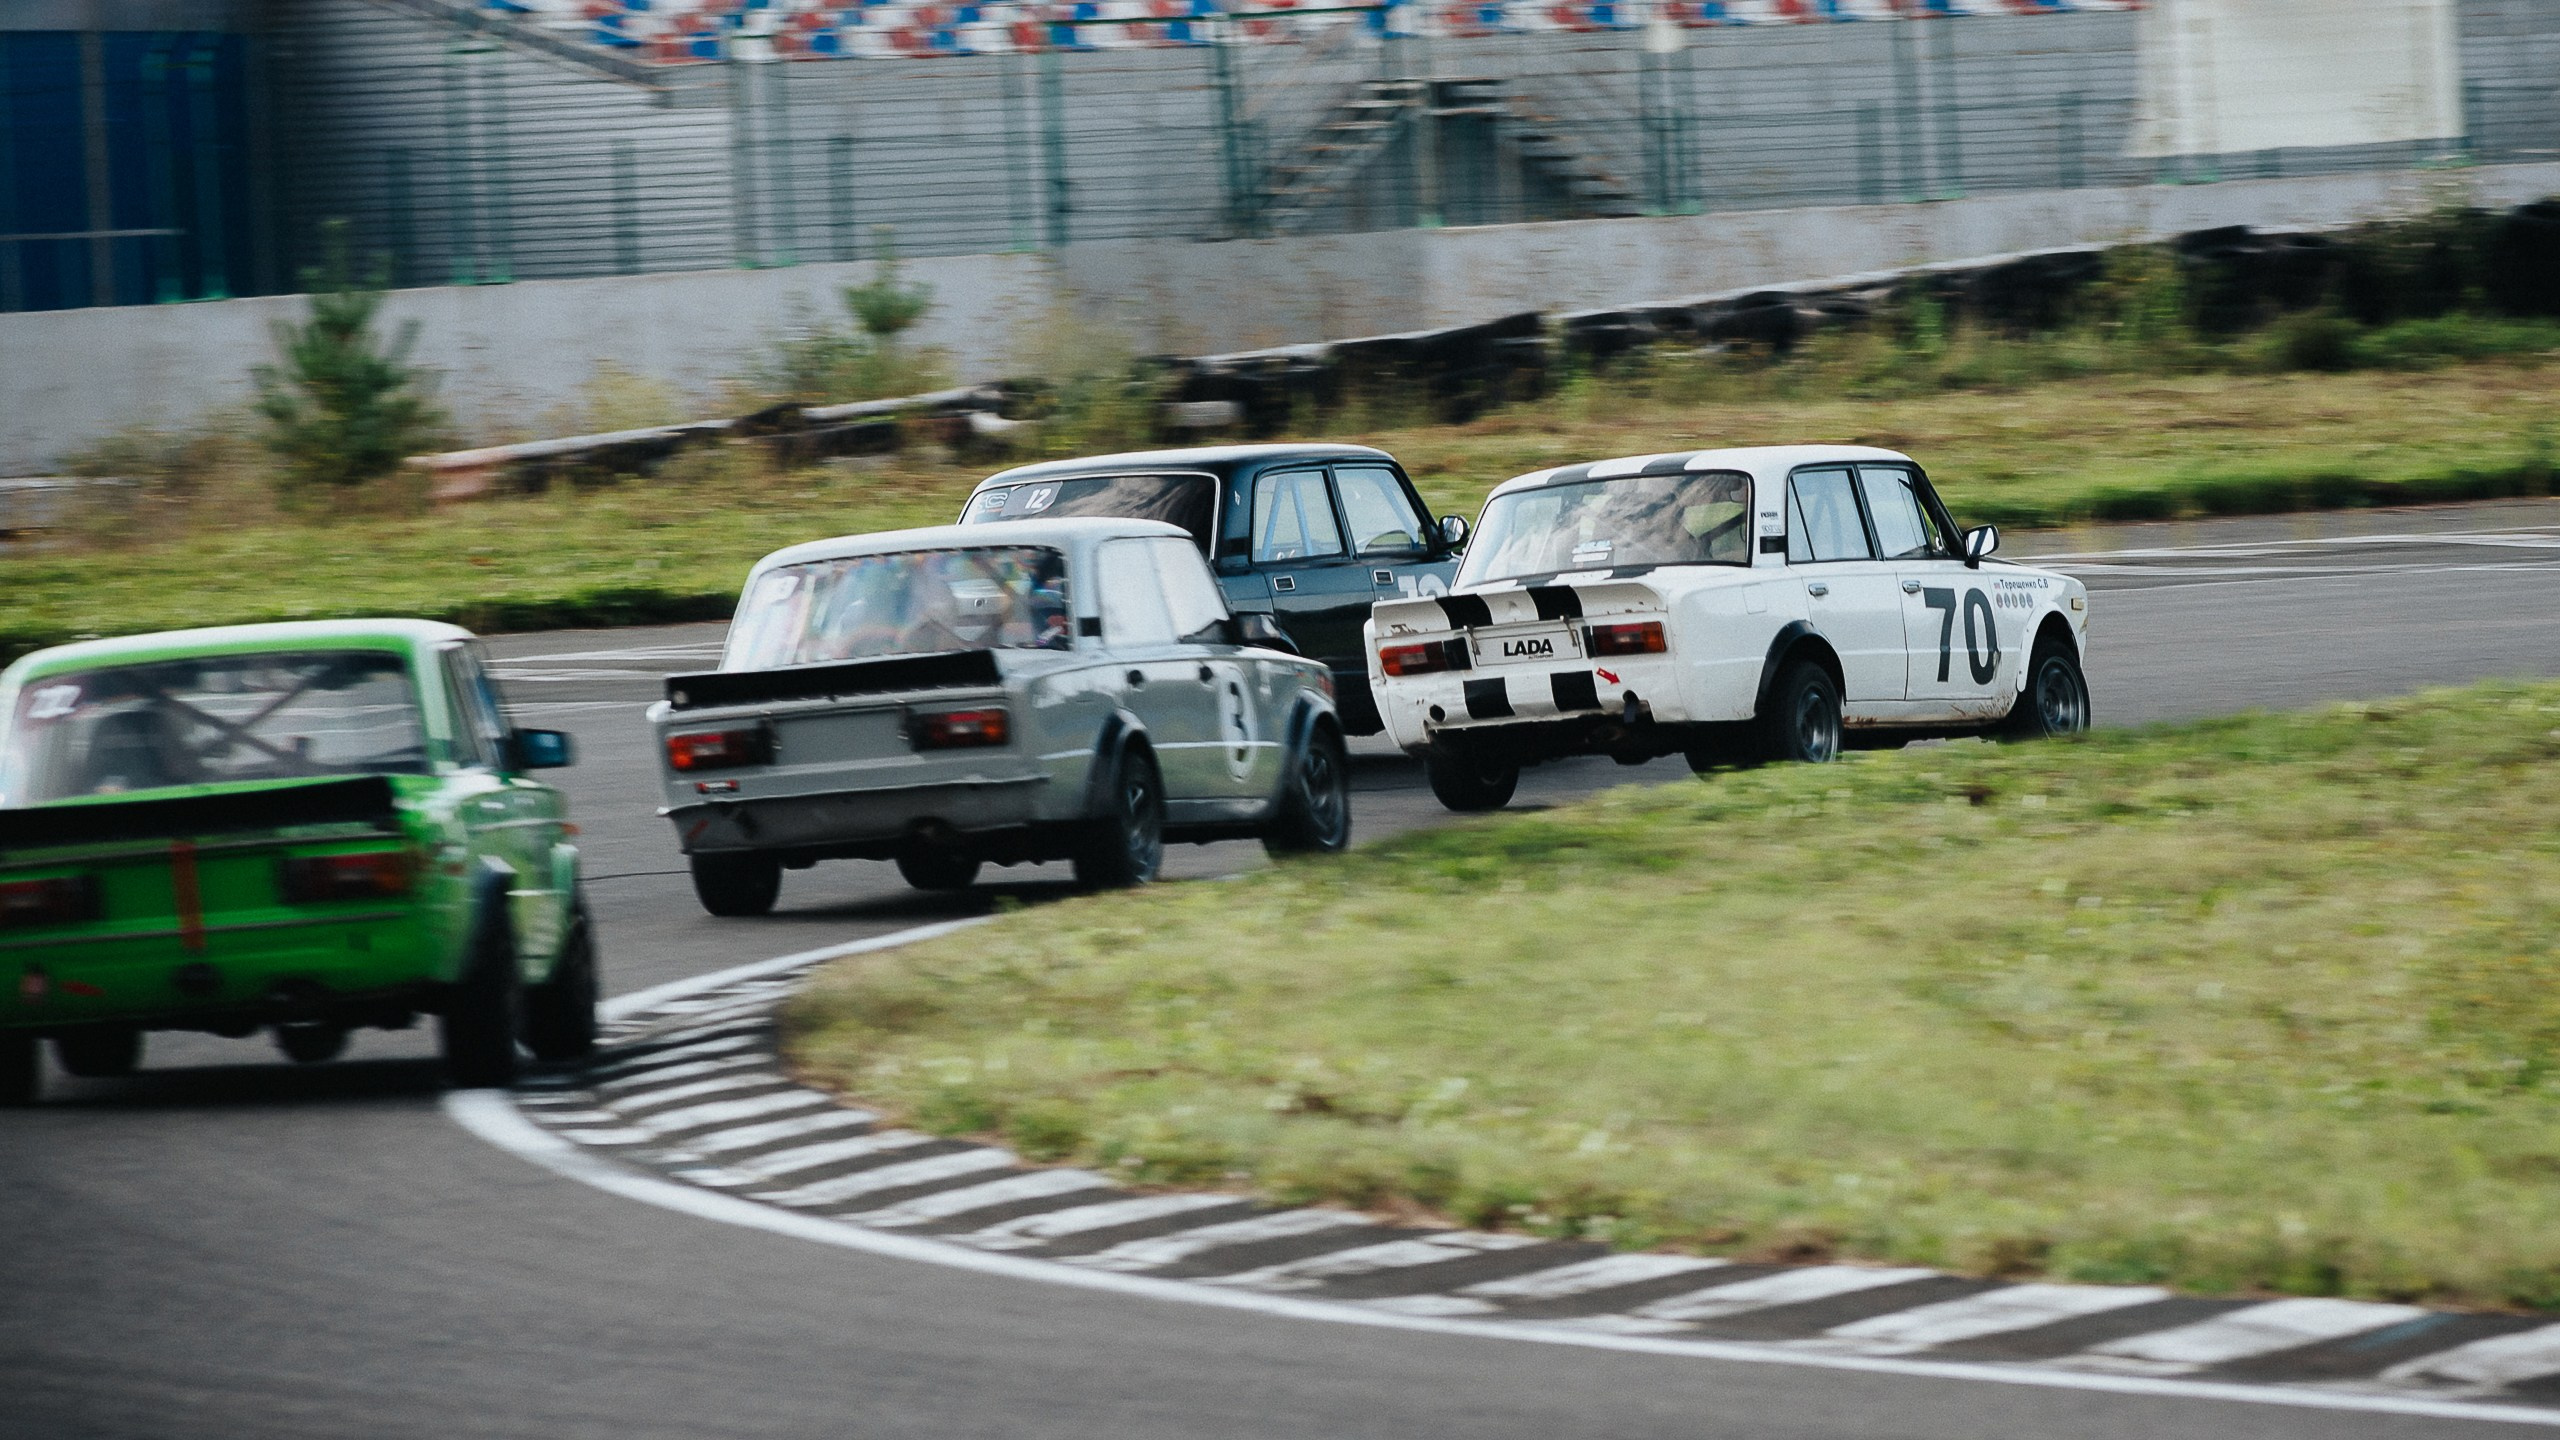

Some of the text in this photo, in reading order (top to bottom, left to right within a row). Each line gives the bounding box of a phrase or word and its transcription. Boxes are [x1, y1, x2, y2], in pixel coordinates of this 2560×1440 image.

[1025, 488, 1051, 509] 12
[2000, 579, 2037, 592] Терещенко
[1923, 587, 2001, 685] 70
[1503, 638, 1554, 657] LADA
